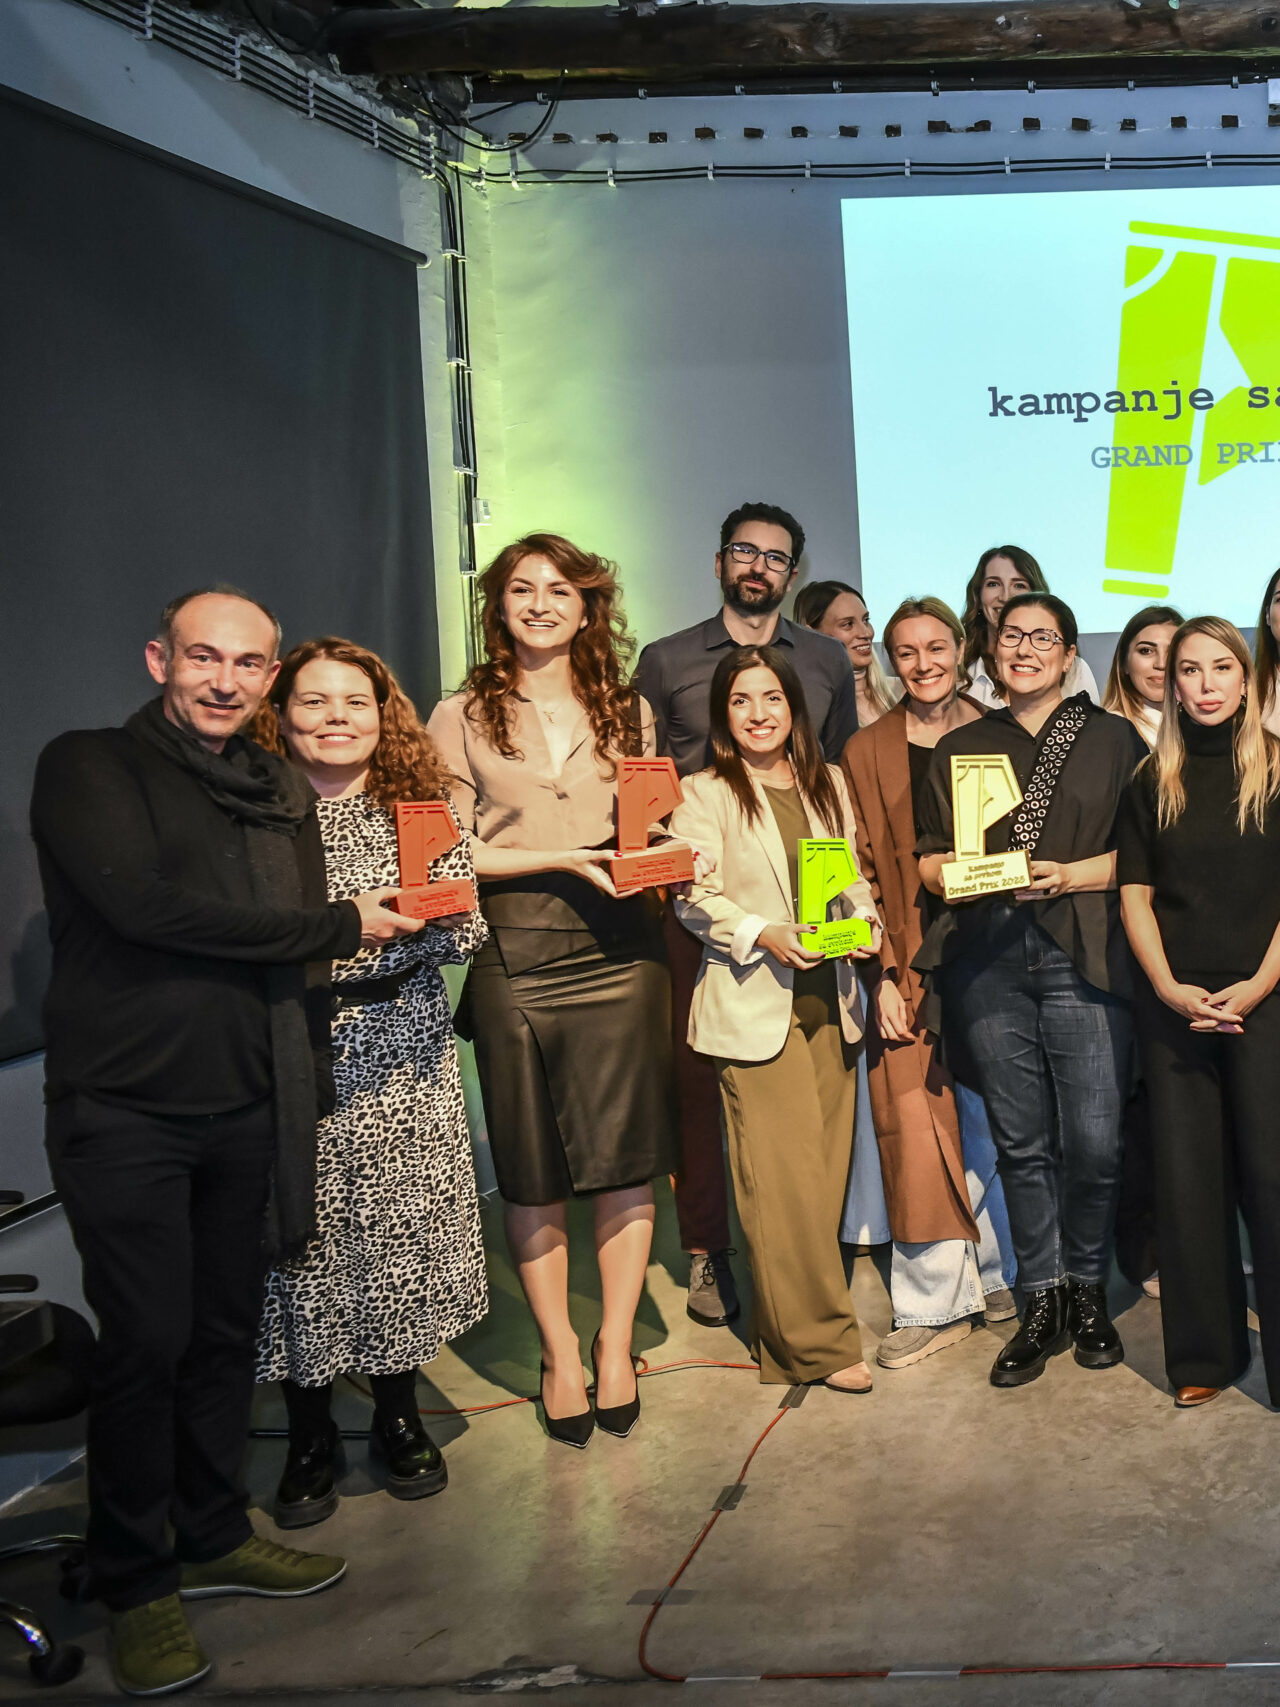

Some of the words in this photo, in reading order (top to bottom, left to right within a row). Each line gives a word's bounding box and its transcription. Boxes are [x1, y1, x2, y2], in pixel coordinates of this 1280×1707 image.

[987, 380, 1214, 423] kampanje
[1091, 444, 1194, 469] GRAND
[949, 883, 977, 895] Grand
[979, 881, 999, 890] Prix
[1001, 875, 1026, 887] 2025
